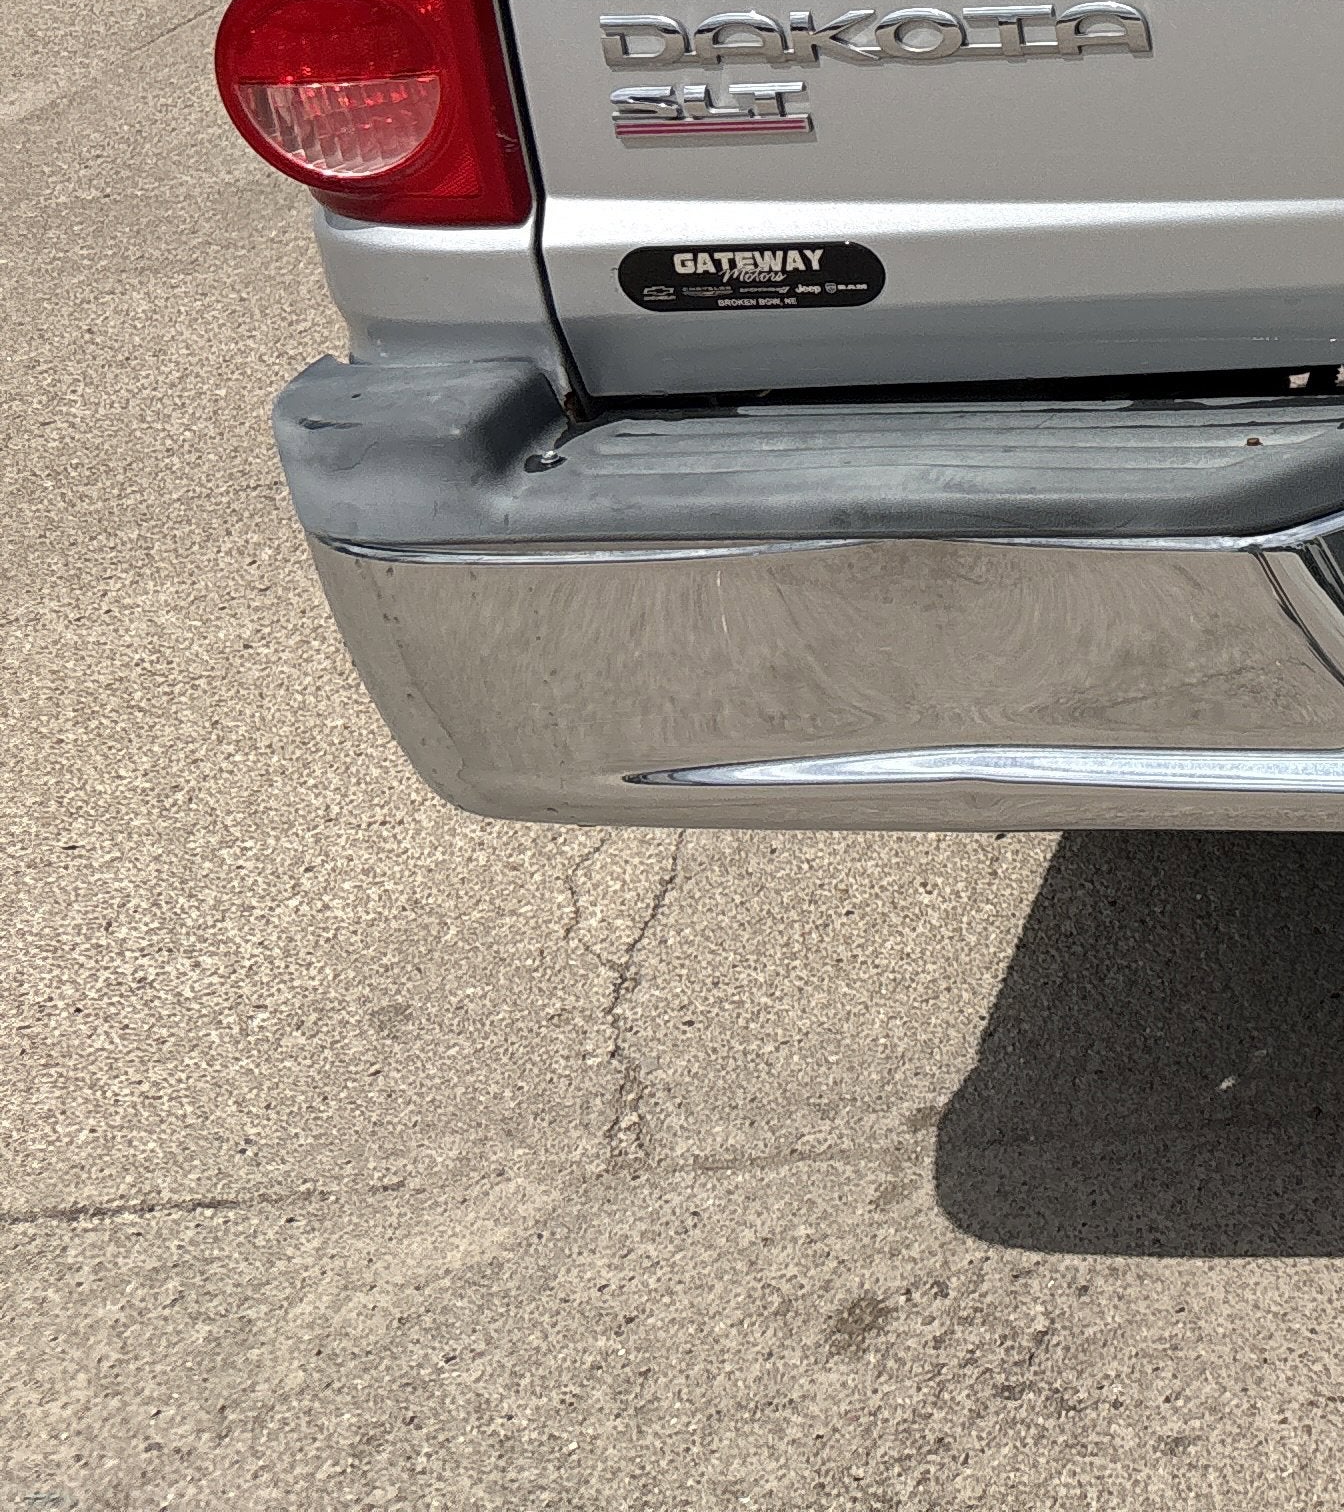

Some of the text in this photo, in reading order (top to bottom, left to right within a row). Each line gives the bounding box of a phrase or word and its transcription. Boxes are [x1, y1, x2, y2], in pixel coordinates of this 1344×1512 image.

[600, 1, 1153, 68] DAKOTA
[610, 82, 806, 119] SLT
[673, 249, 824, 274] GATEWAY
[718, 266, 787, 283] Motors
[717, 298, 756, 307] BROKEN
